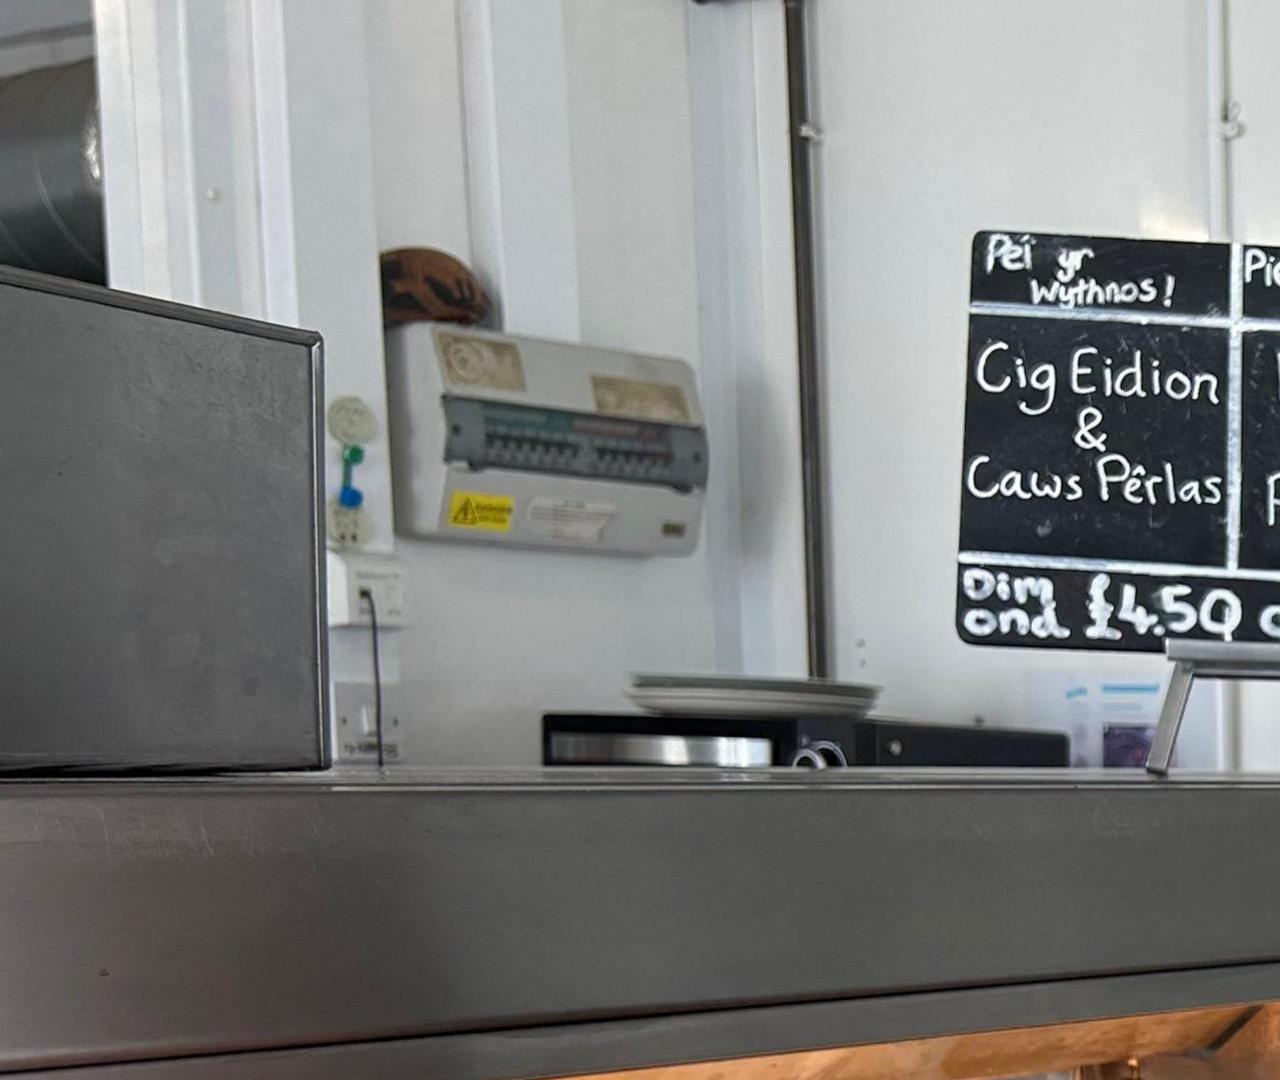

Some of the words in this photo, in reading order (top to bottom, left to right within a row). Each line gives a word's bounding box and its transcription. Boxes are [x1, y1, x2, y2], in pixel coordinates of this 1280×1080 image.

[986, 234, 1037, 274] Pei
[1056, 247, 1095, 282] yr
[976, 340, 1056, 415] Cig
[1071, 346, 1220, 404] Eidion
[1073, 406, 1108, 452] &
[967, 455, 1083, 500] Caws
[1096, 453, 1223, 505] Pêrlas
[963, 567, 1056, 606] Dim
[963, 600, 1071, 638] ond
[1086, 573, 1242, 642] £4.50
